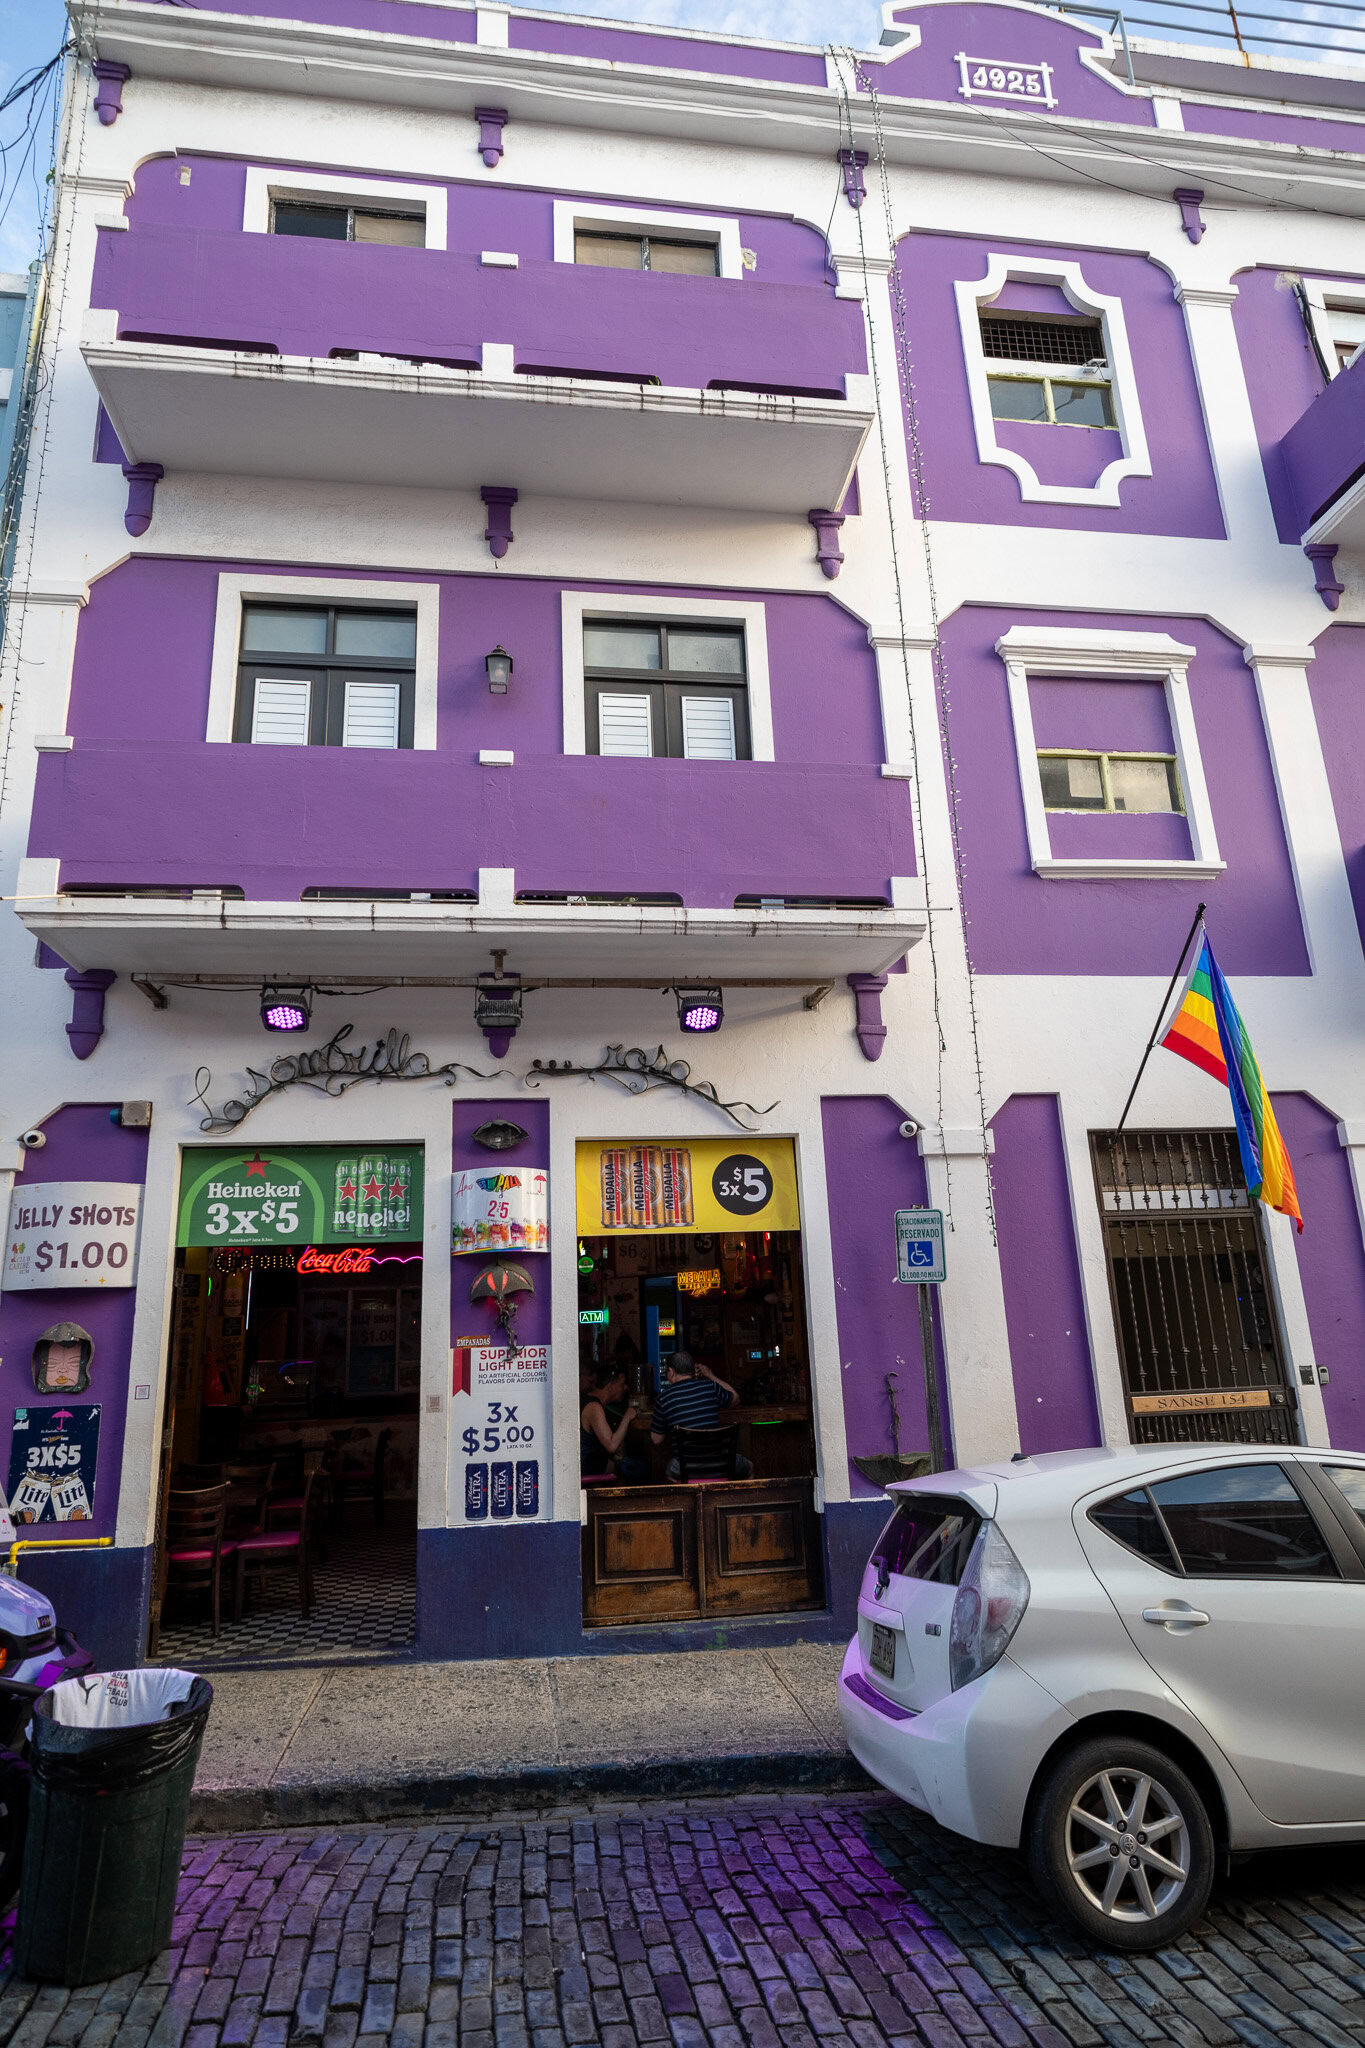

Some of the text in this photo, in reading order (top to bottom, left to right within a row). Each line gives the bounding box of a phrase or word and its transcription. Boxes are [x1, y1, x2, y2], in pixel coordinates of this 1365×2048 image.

[973, 66, 1040, 95] 1925
[207, 1182, 301, 1198] Heineken
[604, 1163, 615, 1211] MEDALLA
[632, 1160, 644, 1211] MEDALLA
[663, 1162, 674, 1210] MEDALLA
[14, 1203, 136, 1230] JELLY SHOTS
[898, 1217, 940, 1226] ESTACIONAMIENTO
[900, 1228, 940, 1239] RESERVADO
[34, 1240, 128, 1273] $1.00
[677, 1269, 721, 1284] MEDALLA
[581, 1312, 602, 1322] ATM
[456, 1338, 491, 1347] EMPANADAS
[478, 1360, 547, 1371] LIGHT BEER
[1158, 1395, 1247, 1409] SANSE 154
[461, 1426, 534, 1456] $5.00
[26, 1443, 82, 1469] 3X$5
[19, 1484, 50, 1505] Lite
[57, 1484, 85, 1508] Lite
[472, 1470, 481, 1509] ULTRA
[498, 1469, 506, 1508] ULTRA
[523, 1468, 531, 1506] ULTRA
[109, 1696, 128, 1706] CLUB
